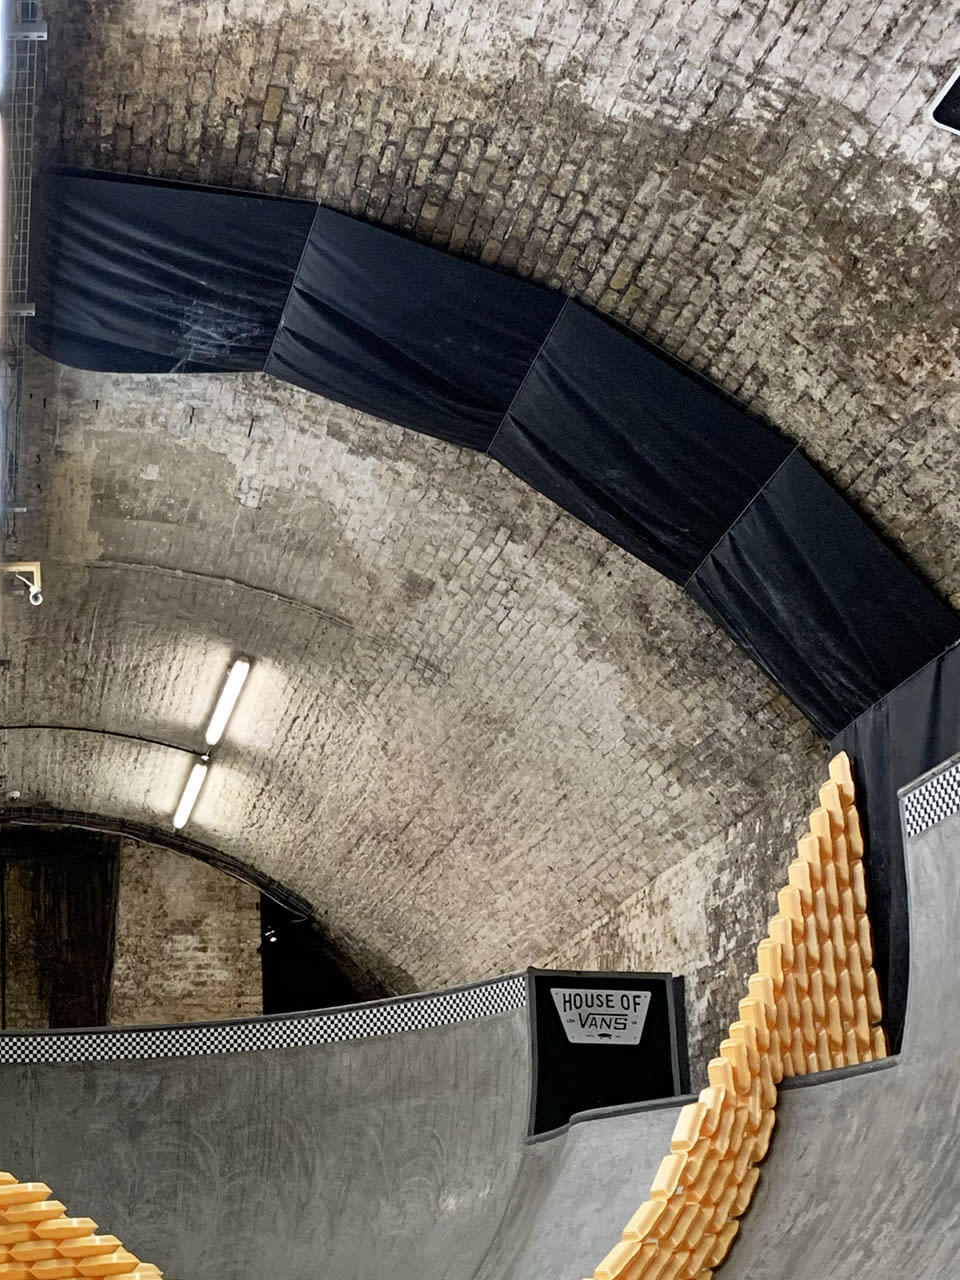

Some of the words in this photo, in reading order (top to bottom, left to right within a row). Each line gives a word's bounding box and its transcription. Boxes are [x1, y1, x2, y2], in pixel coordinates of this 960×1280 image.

[562, 993, 615, 1012] HOUSE
[620, 994, 642, 1013] OF
[578, 1012, 628, 1030] VANS
